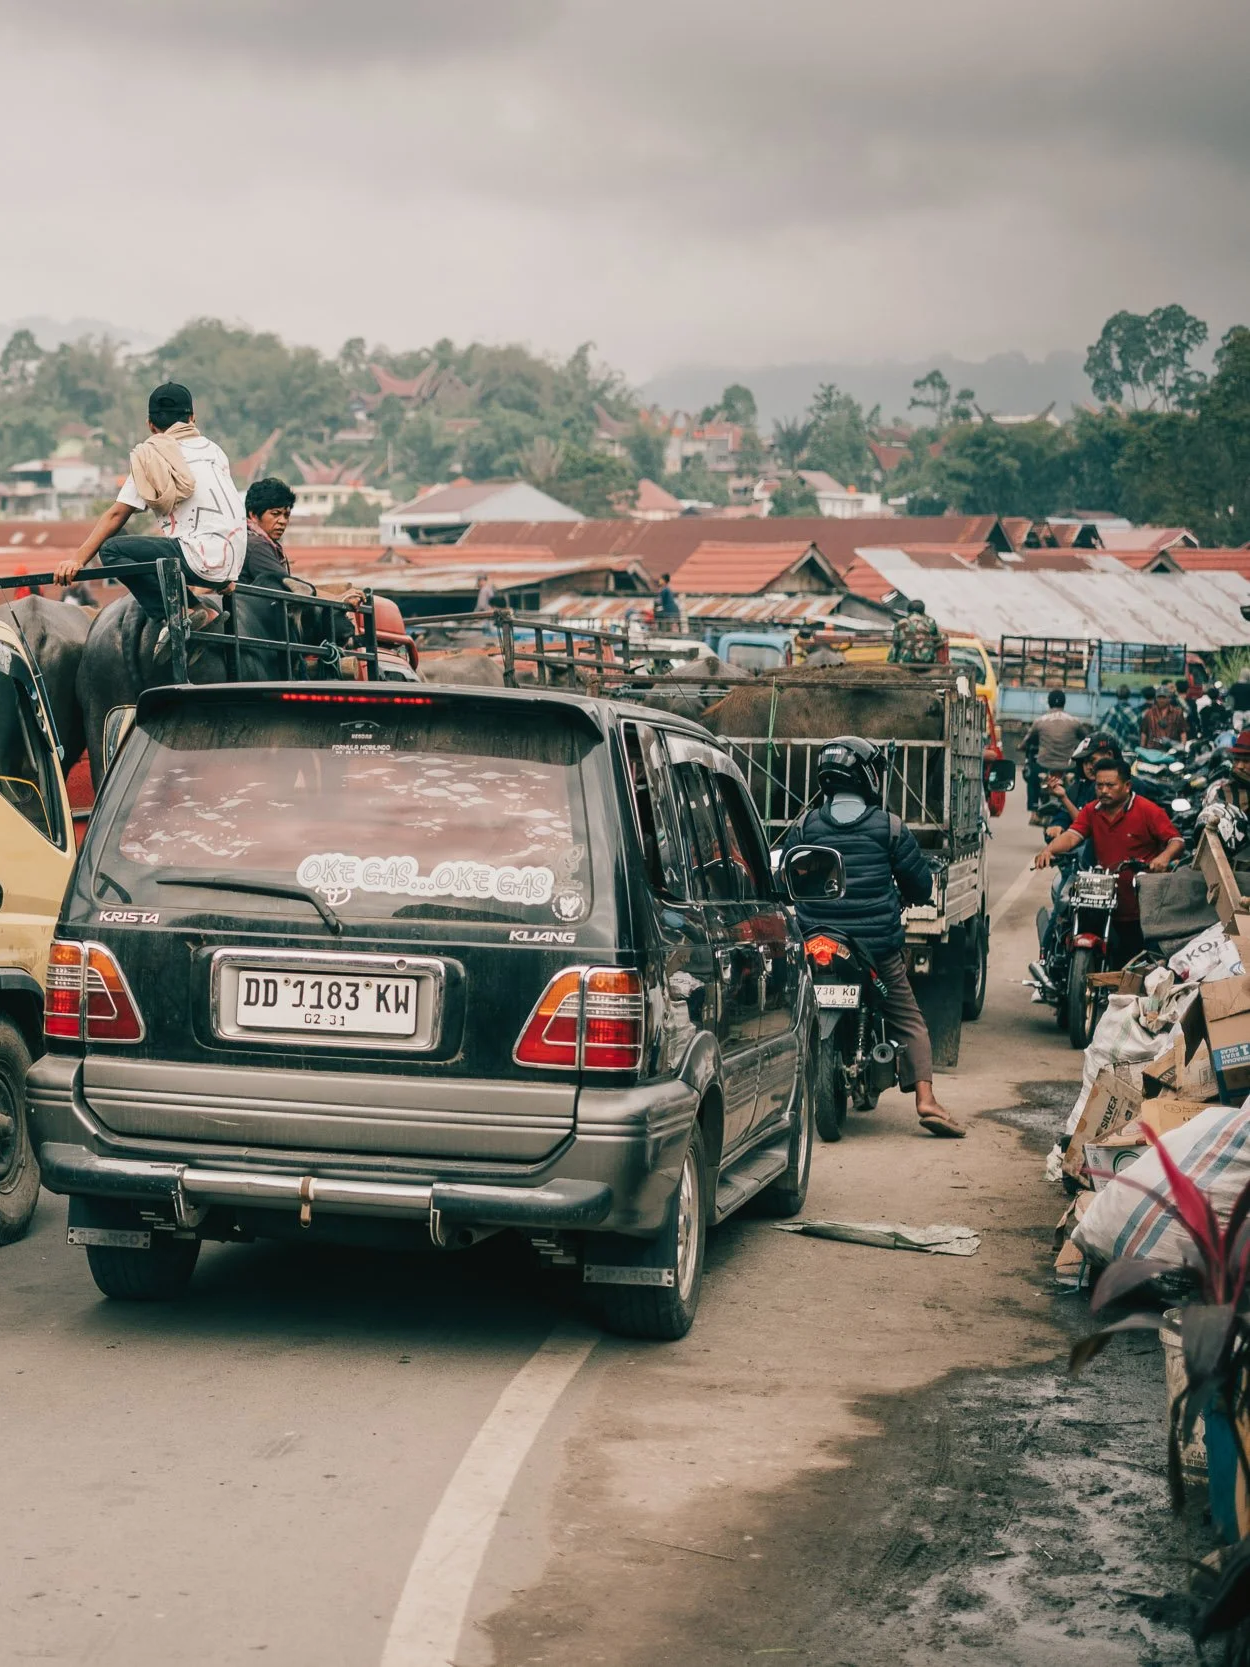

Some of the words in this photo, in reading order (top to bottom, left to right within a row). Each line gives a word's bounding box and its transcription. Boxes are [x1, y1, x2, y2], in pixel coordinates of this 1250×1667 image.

[302, 857, 357, 884] OKE
[496, 870, 548, 899] GAS
[99, 910, 160, 924] KRISTA
[509, 930, 576, 944] KIJANG
[243, 977, 278, 1007] DD
[291, 980, 360, 1011] 1183
[375, 983, 410, 1014] KW
[1101, 1095, 1118, 1130] SILVER
